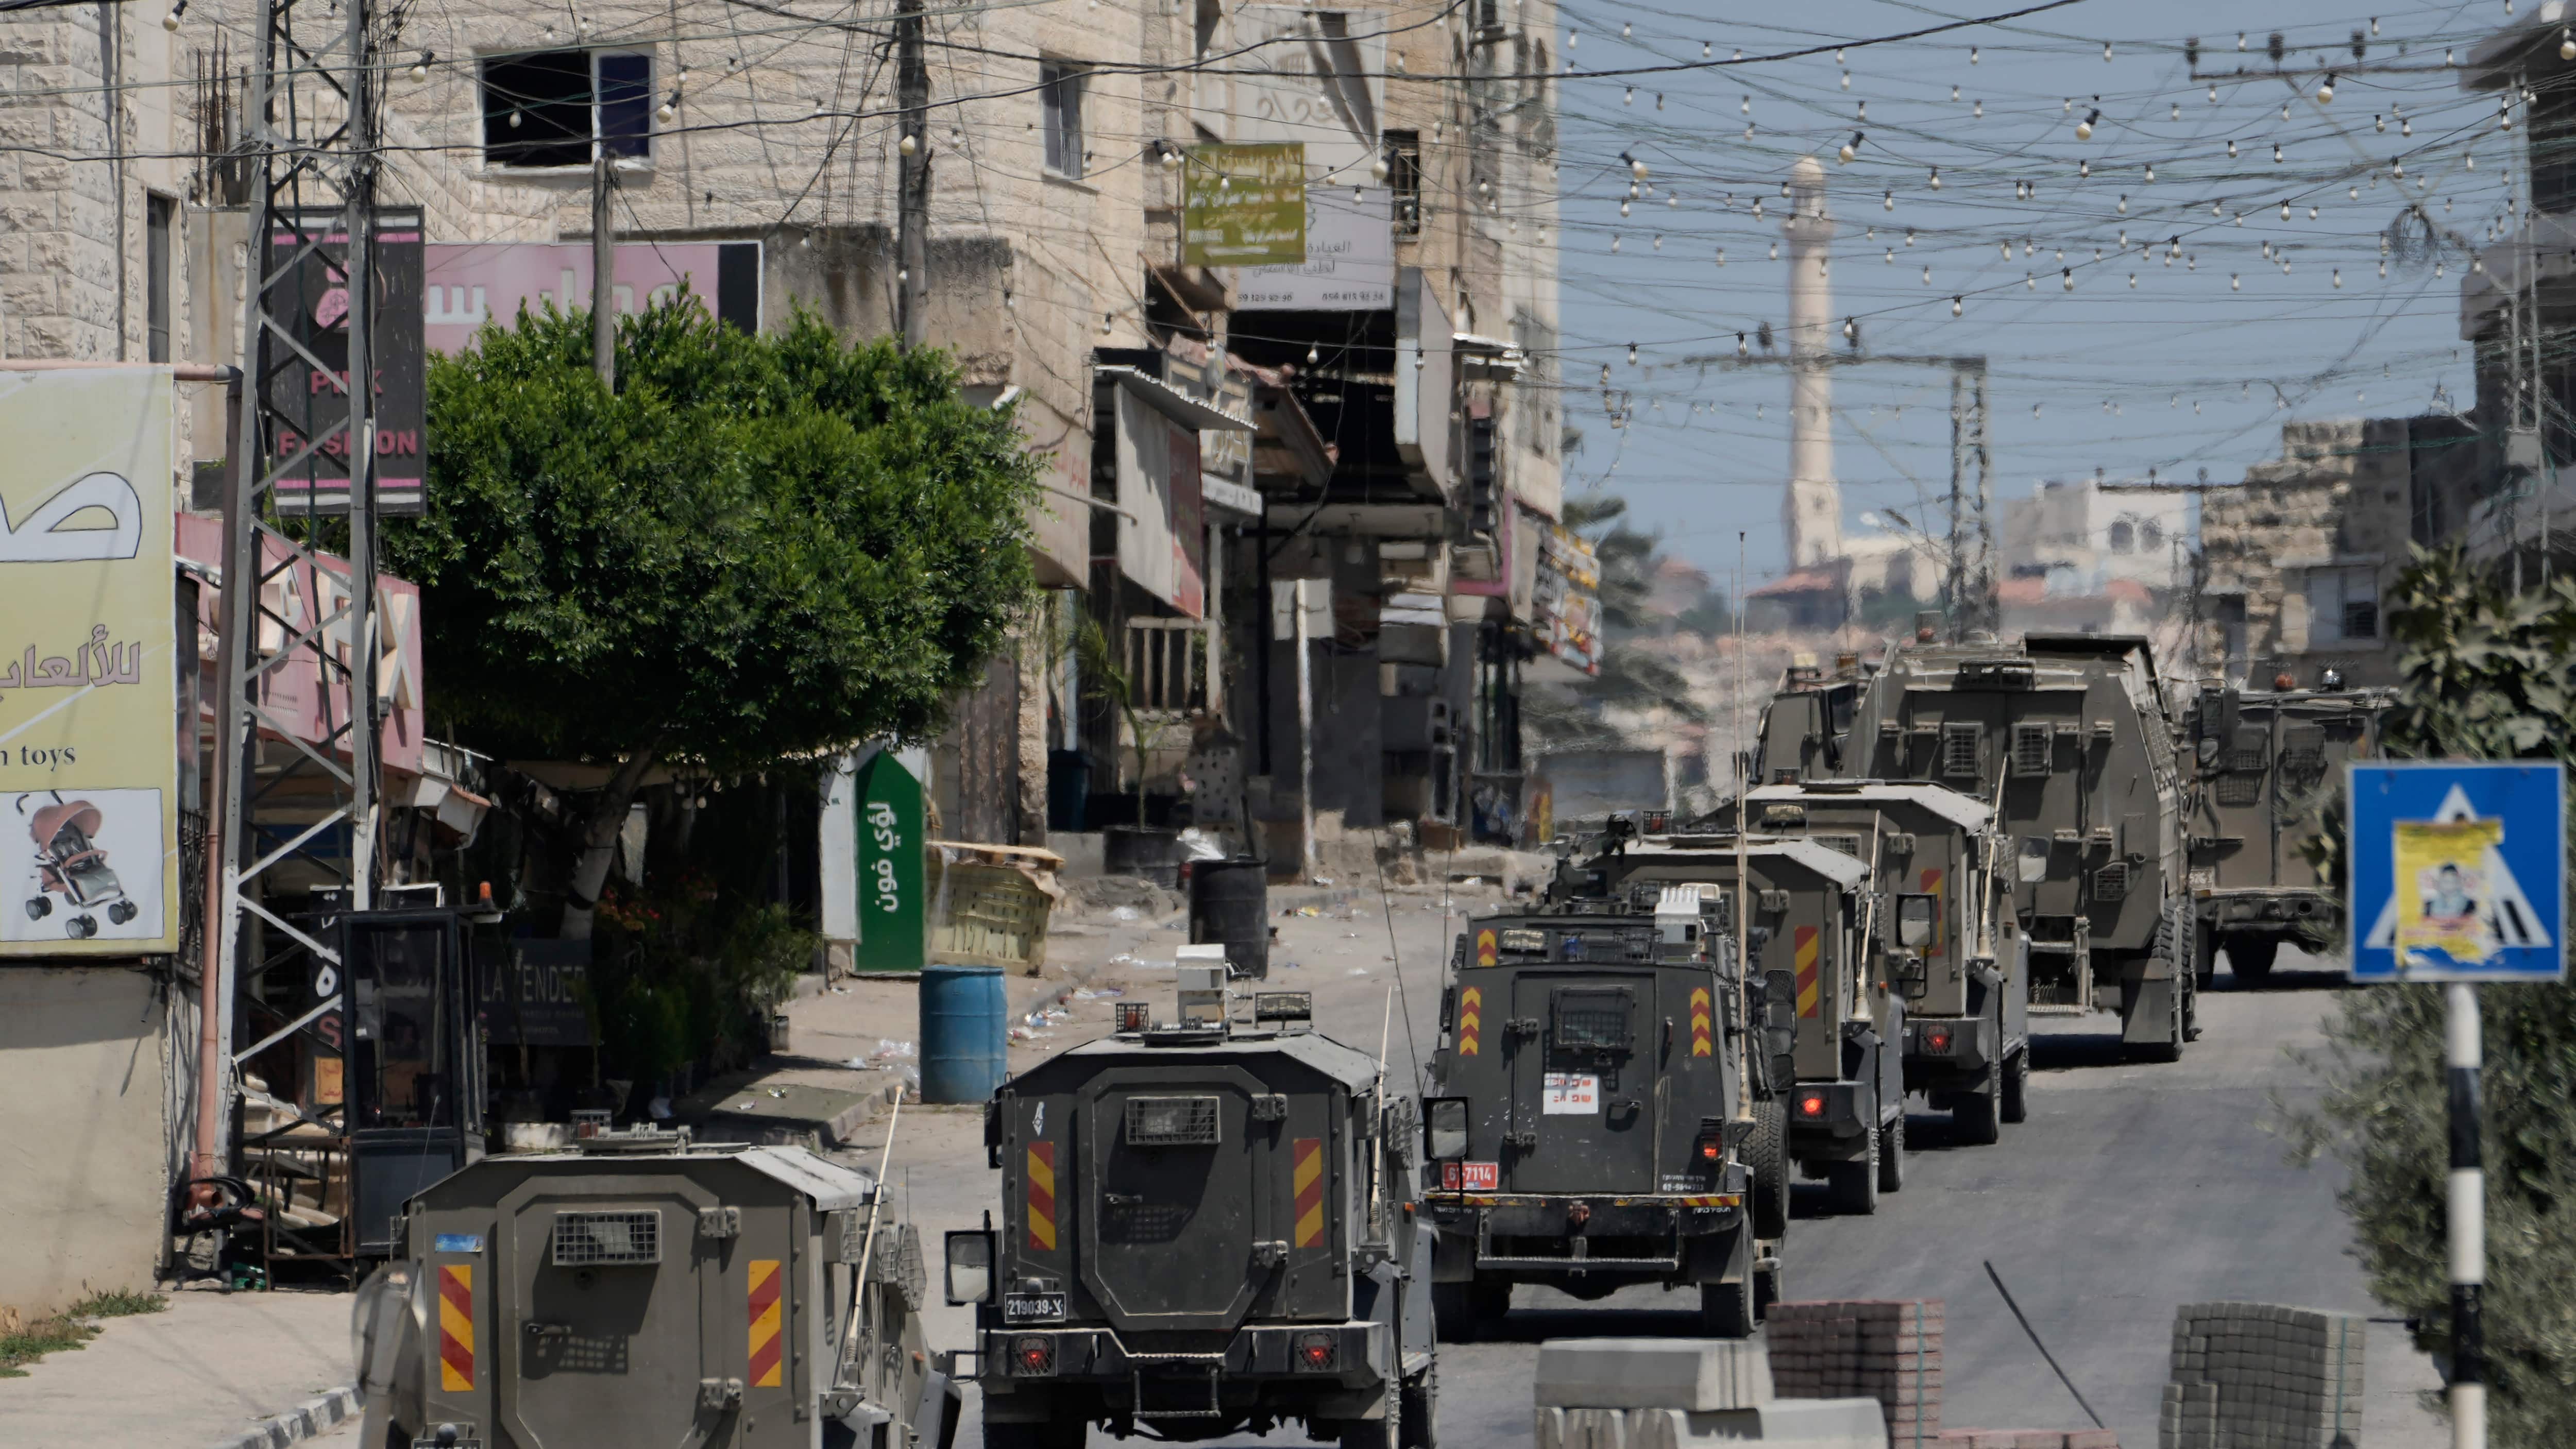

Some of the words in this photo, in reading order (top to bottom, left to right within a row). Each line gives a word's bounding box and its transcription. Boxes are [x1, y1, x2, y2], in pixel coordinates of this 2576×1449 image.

[21, 745, 76, 772] toys
[867, 802, 902, 851] لؤي
[871, 858, 899, 913] فون
